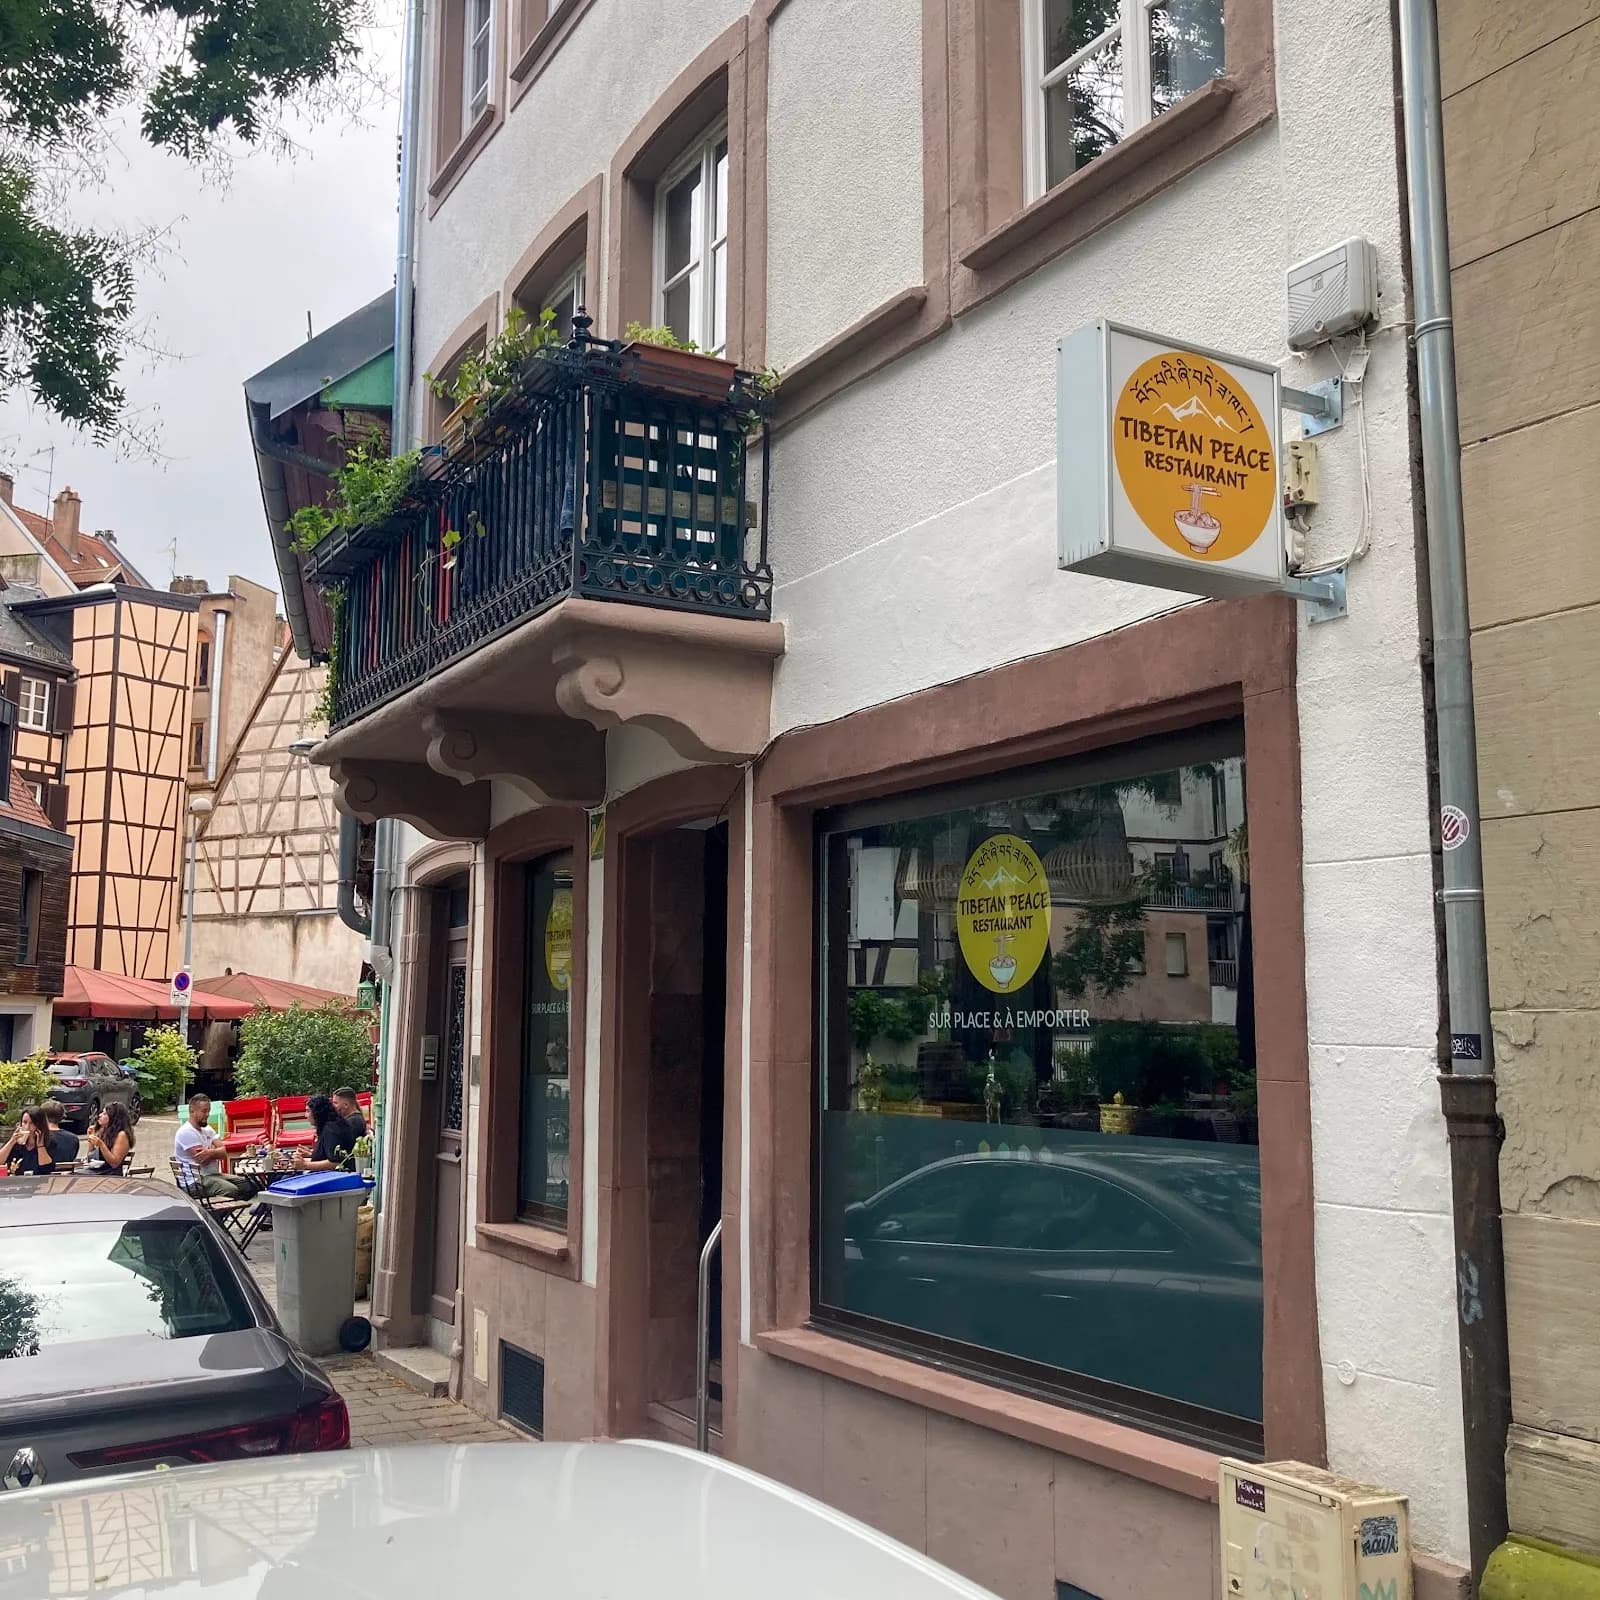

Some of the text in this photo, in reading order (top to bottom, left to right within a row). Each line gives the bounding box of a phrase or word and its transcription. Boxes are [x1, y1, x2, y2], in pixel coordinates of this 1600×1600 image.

[1119, 416, 1271, 472] TIBETAN PEACE
[1143, 450, 1249, 490] RESTAURANT
[960, 891, 1049, 916] TIBETAN PEACE
[972, 915, 1034, 933] RESTAURANT
[929, 1007, 1090, 1028] SUR PLACE & À EMPORTER
